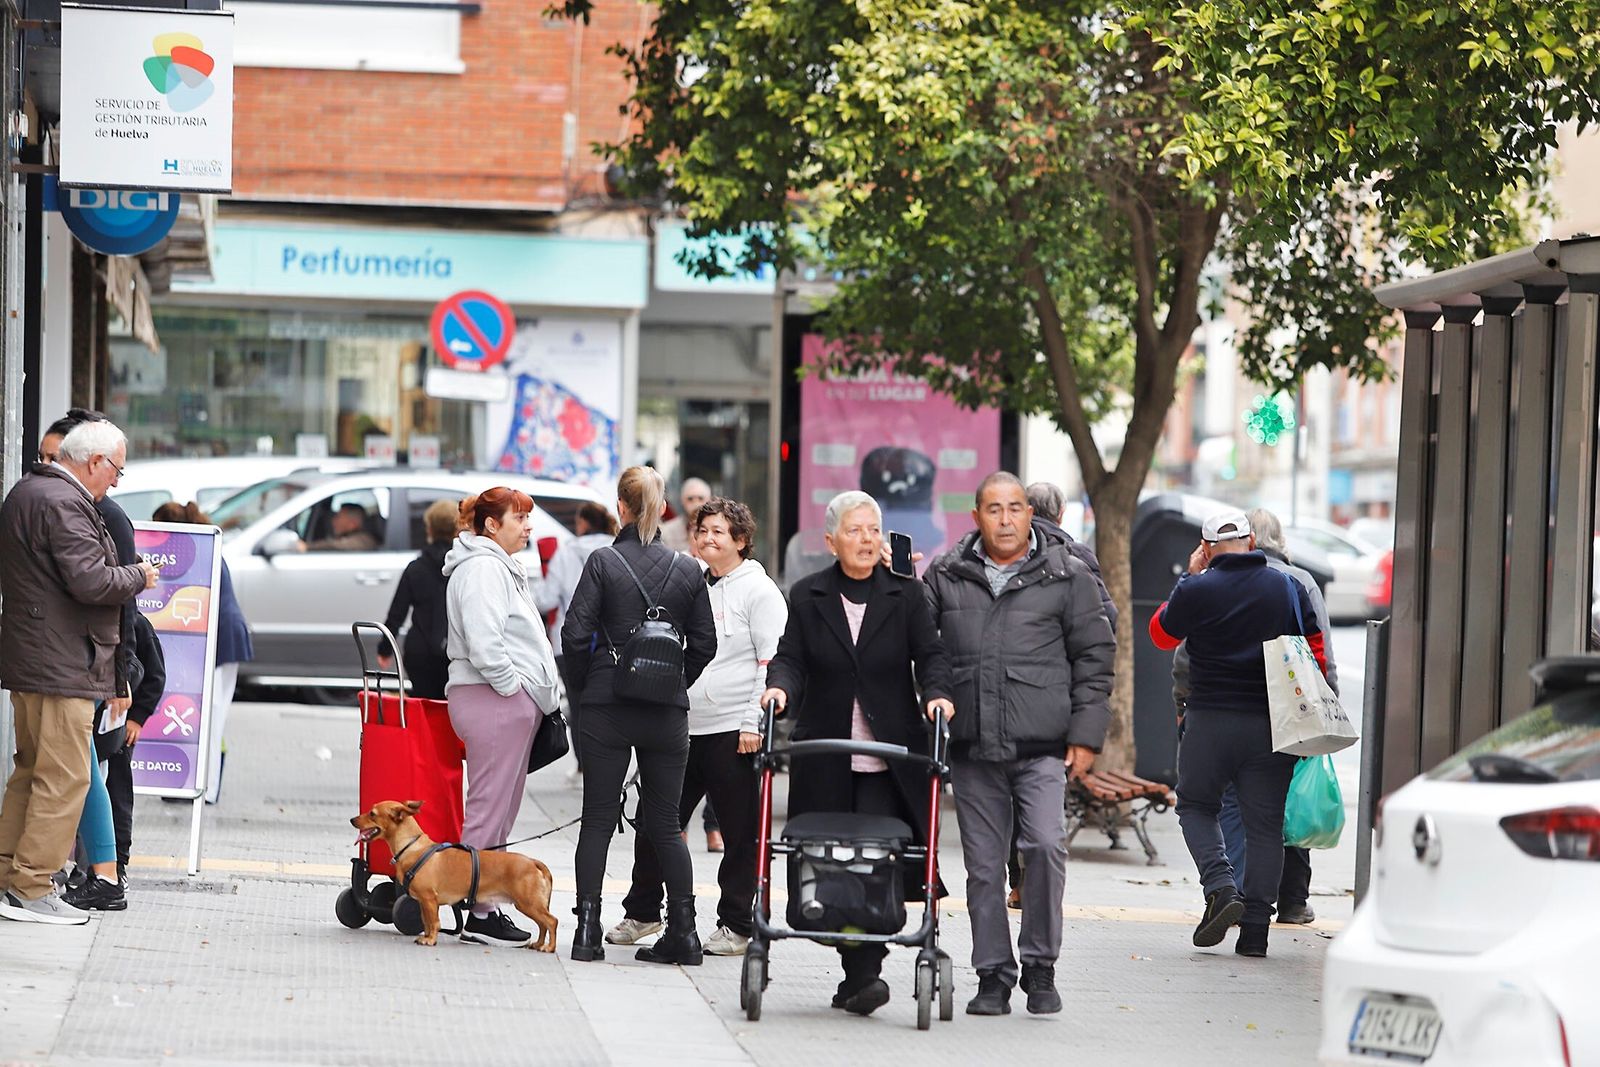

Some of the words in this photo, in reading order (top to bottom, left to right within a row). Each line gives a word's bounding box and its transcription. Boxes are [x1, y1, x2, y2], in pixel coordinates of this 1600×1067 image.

[95, 99, 144, 110] SERVICIO
[146, 100, 161, 110] DE
[95, 112, 142, 124] GESTIÓN
[145, 115, 208, 127] TRIBUTARIA
[95, 128, 108, 138] de
[111, 129, 149, 139] Huelva
[70, 189, 168, 211] DIGI
[282, 245, 452, 278] Perfumería
[868, 385, 927, 401] LUGAR
[131, 760, 145, 770] DE
[147, 761, 182, 772] DATOS
